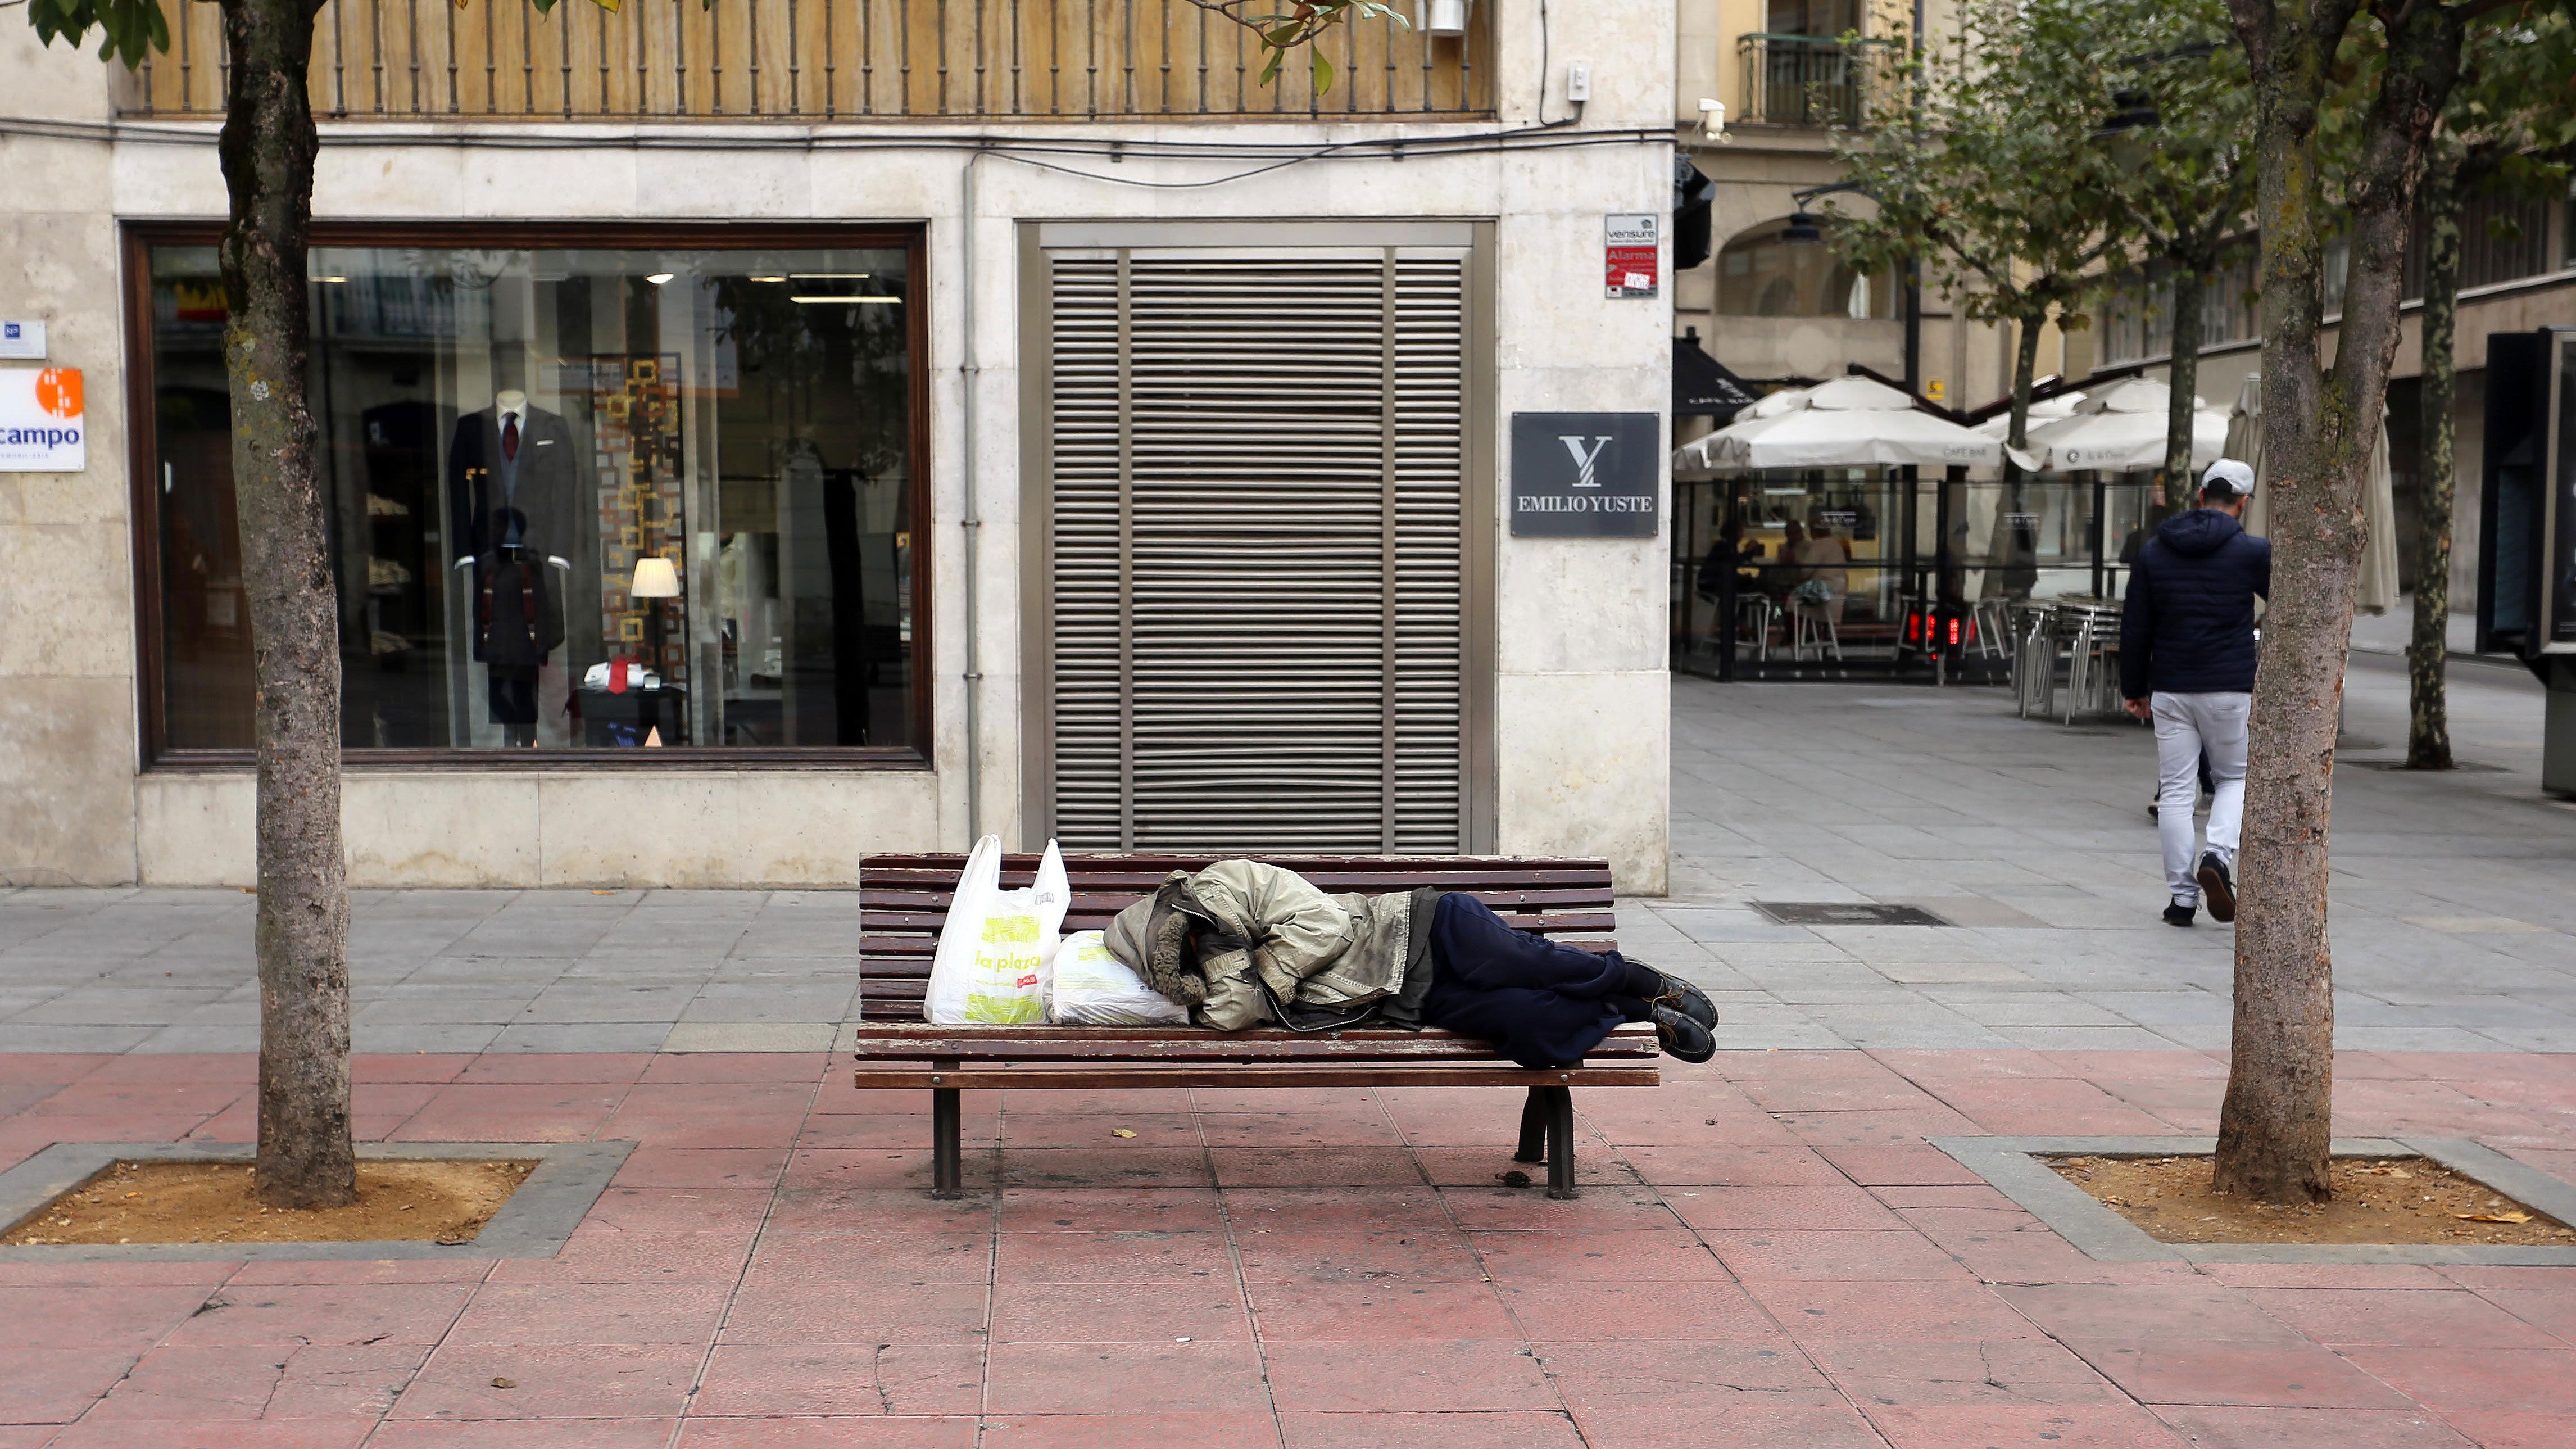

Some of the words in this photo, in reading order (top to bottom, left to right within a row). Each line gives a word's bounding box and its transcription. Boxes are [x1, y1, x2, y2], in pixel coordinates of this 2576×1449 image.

[1608, 250, 1655, 260] Alarma
[1518, 496, 1588, 513] EMILIO
[1589, 496, 1653, 513] YUSTE
[974, 950, 992, 969] la
[997, 952, 1041, 973] plaza
